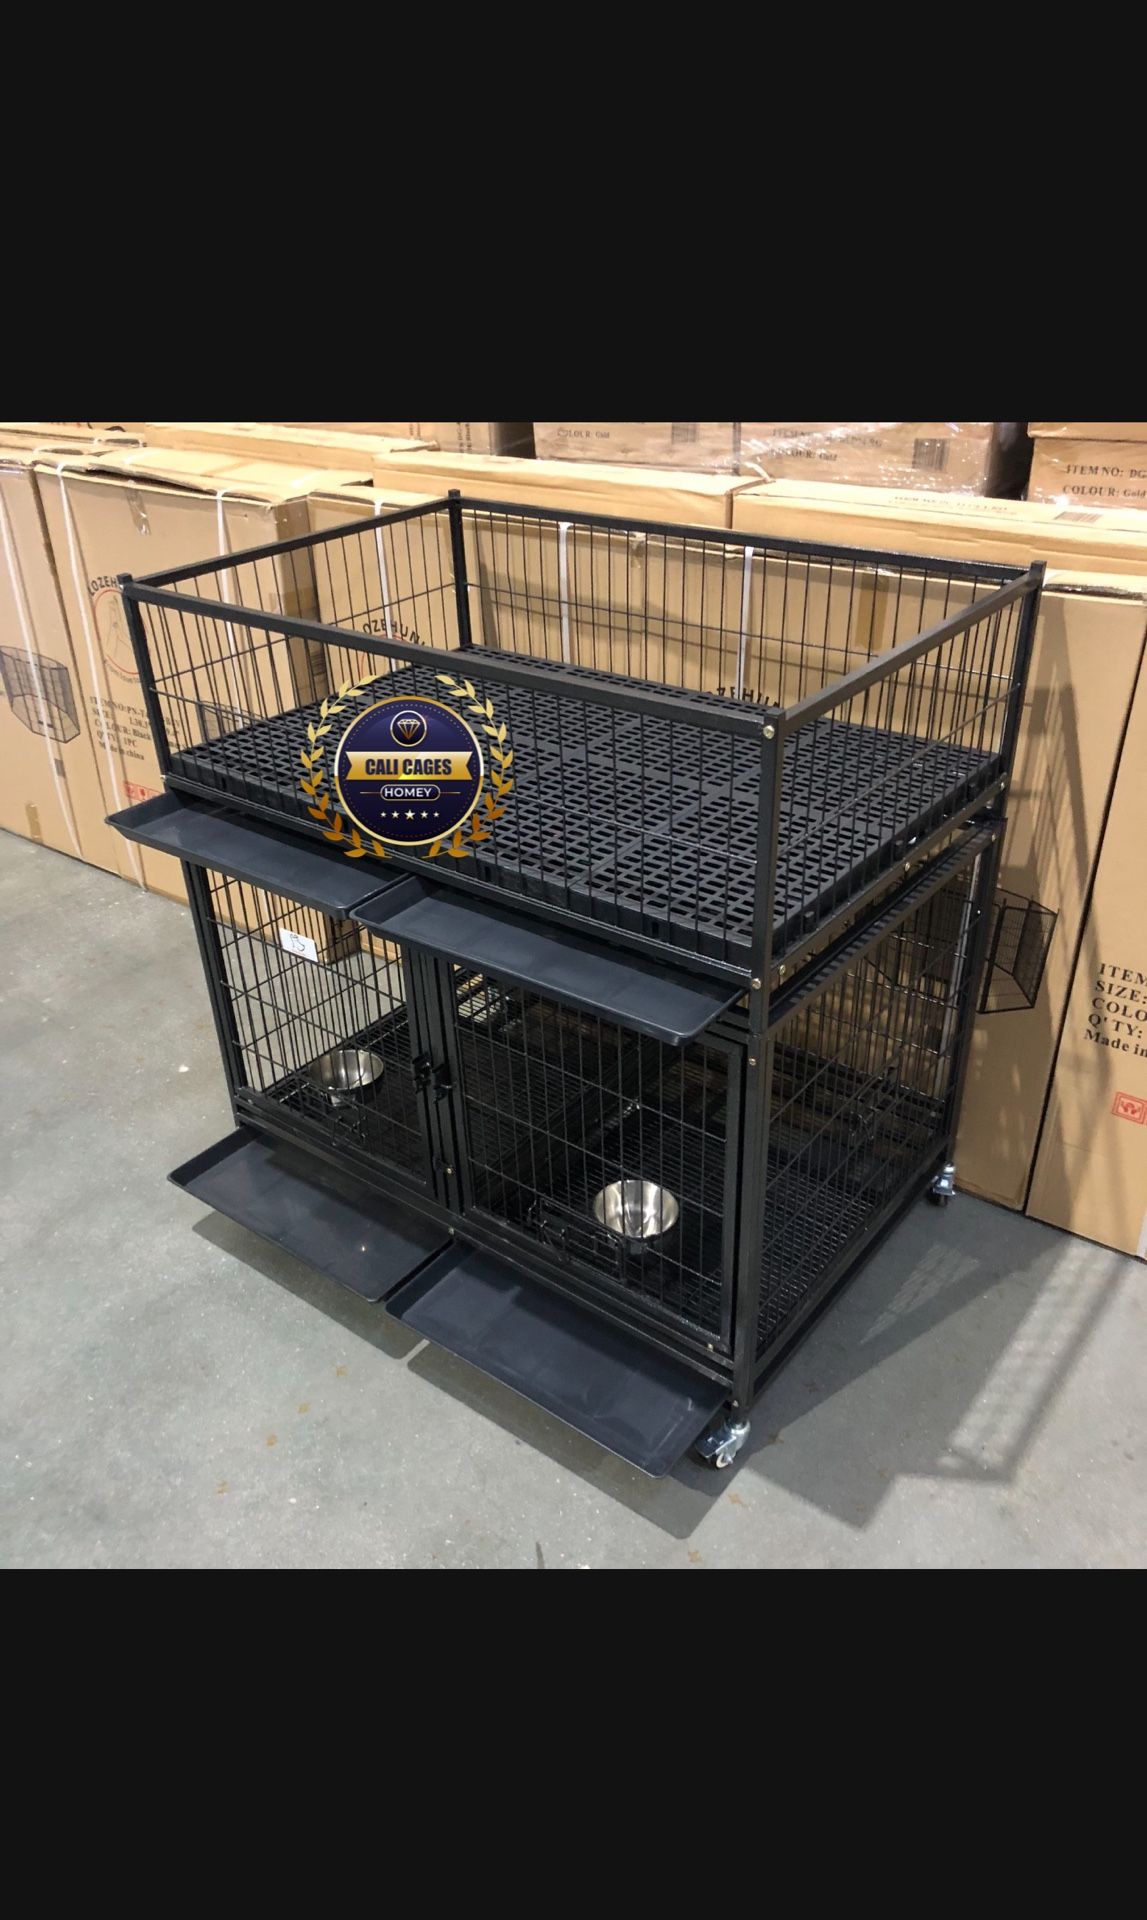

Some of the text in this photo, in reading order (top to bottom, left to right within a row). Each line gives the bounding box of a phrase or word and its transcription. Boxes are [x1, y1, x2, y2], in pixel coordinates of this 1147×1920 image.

[1066, 464, 1099, 476] ITEM
[1102, 466, 1124, 477] NO:
[1063, 485, 1147, 498] COLOUR: Gold
[1095, 980, 1147, 1005] SIZE:
[1083, 1028, 1130, 1052] Made
